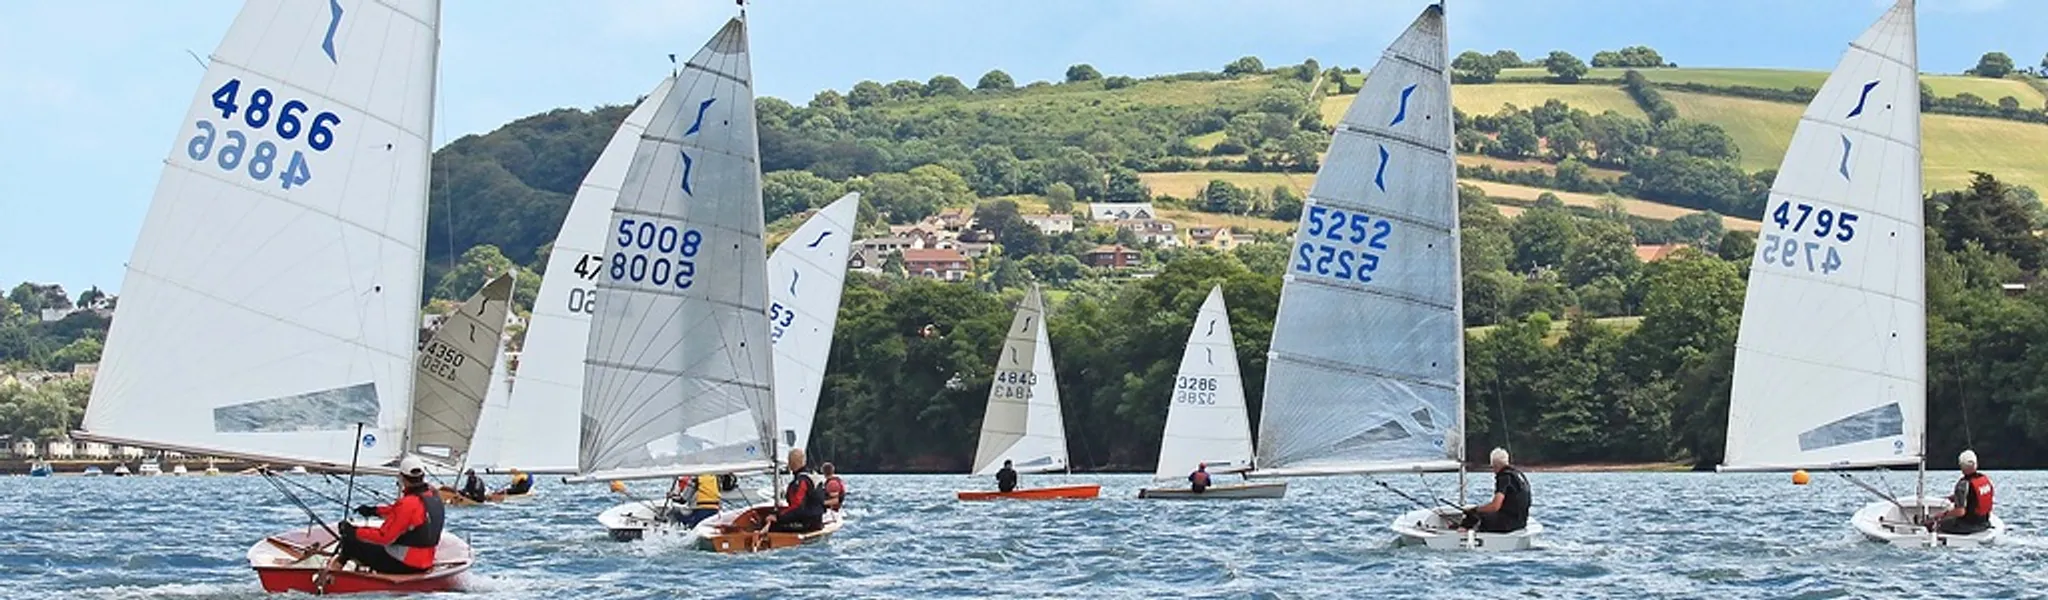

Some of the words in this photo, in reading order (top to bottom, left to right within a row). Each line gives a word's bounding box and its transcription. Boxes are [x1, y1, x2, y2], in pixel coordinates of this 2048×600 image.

[211, 78, 342, 151] 4866
[617, 219, 702, 258] 5008
[1308, 206, 1392, 251] 5252
[1772, 200, 1859, 243] 4795
[428, 342, 465, 368] 4350
[997, 371, 1037, 386] 4843
[1178, 376, 1218, 391] 3286
